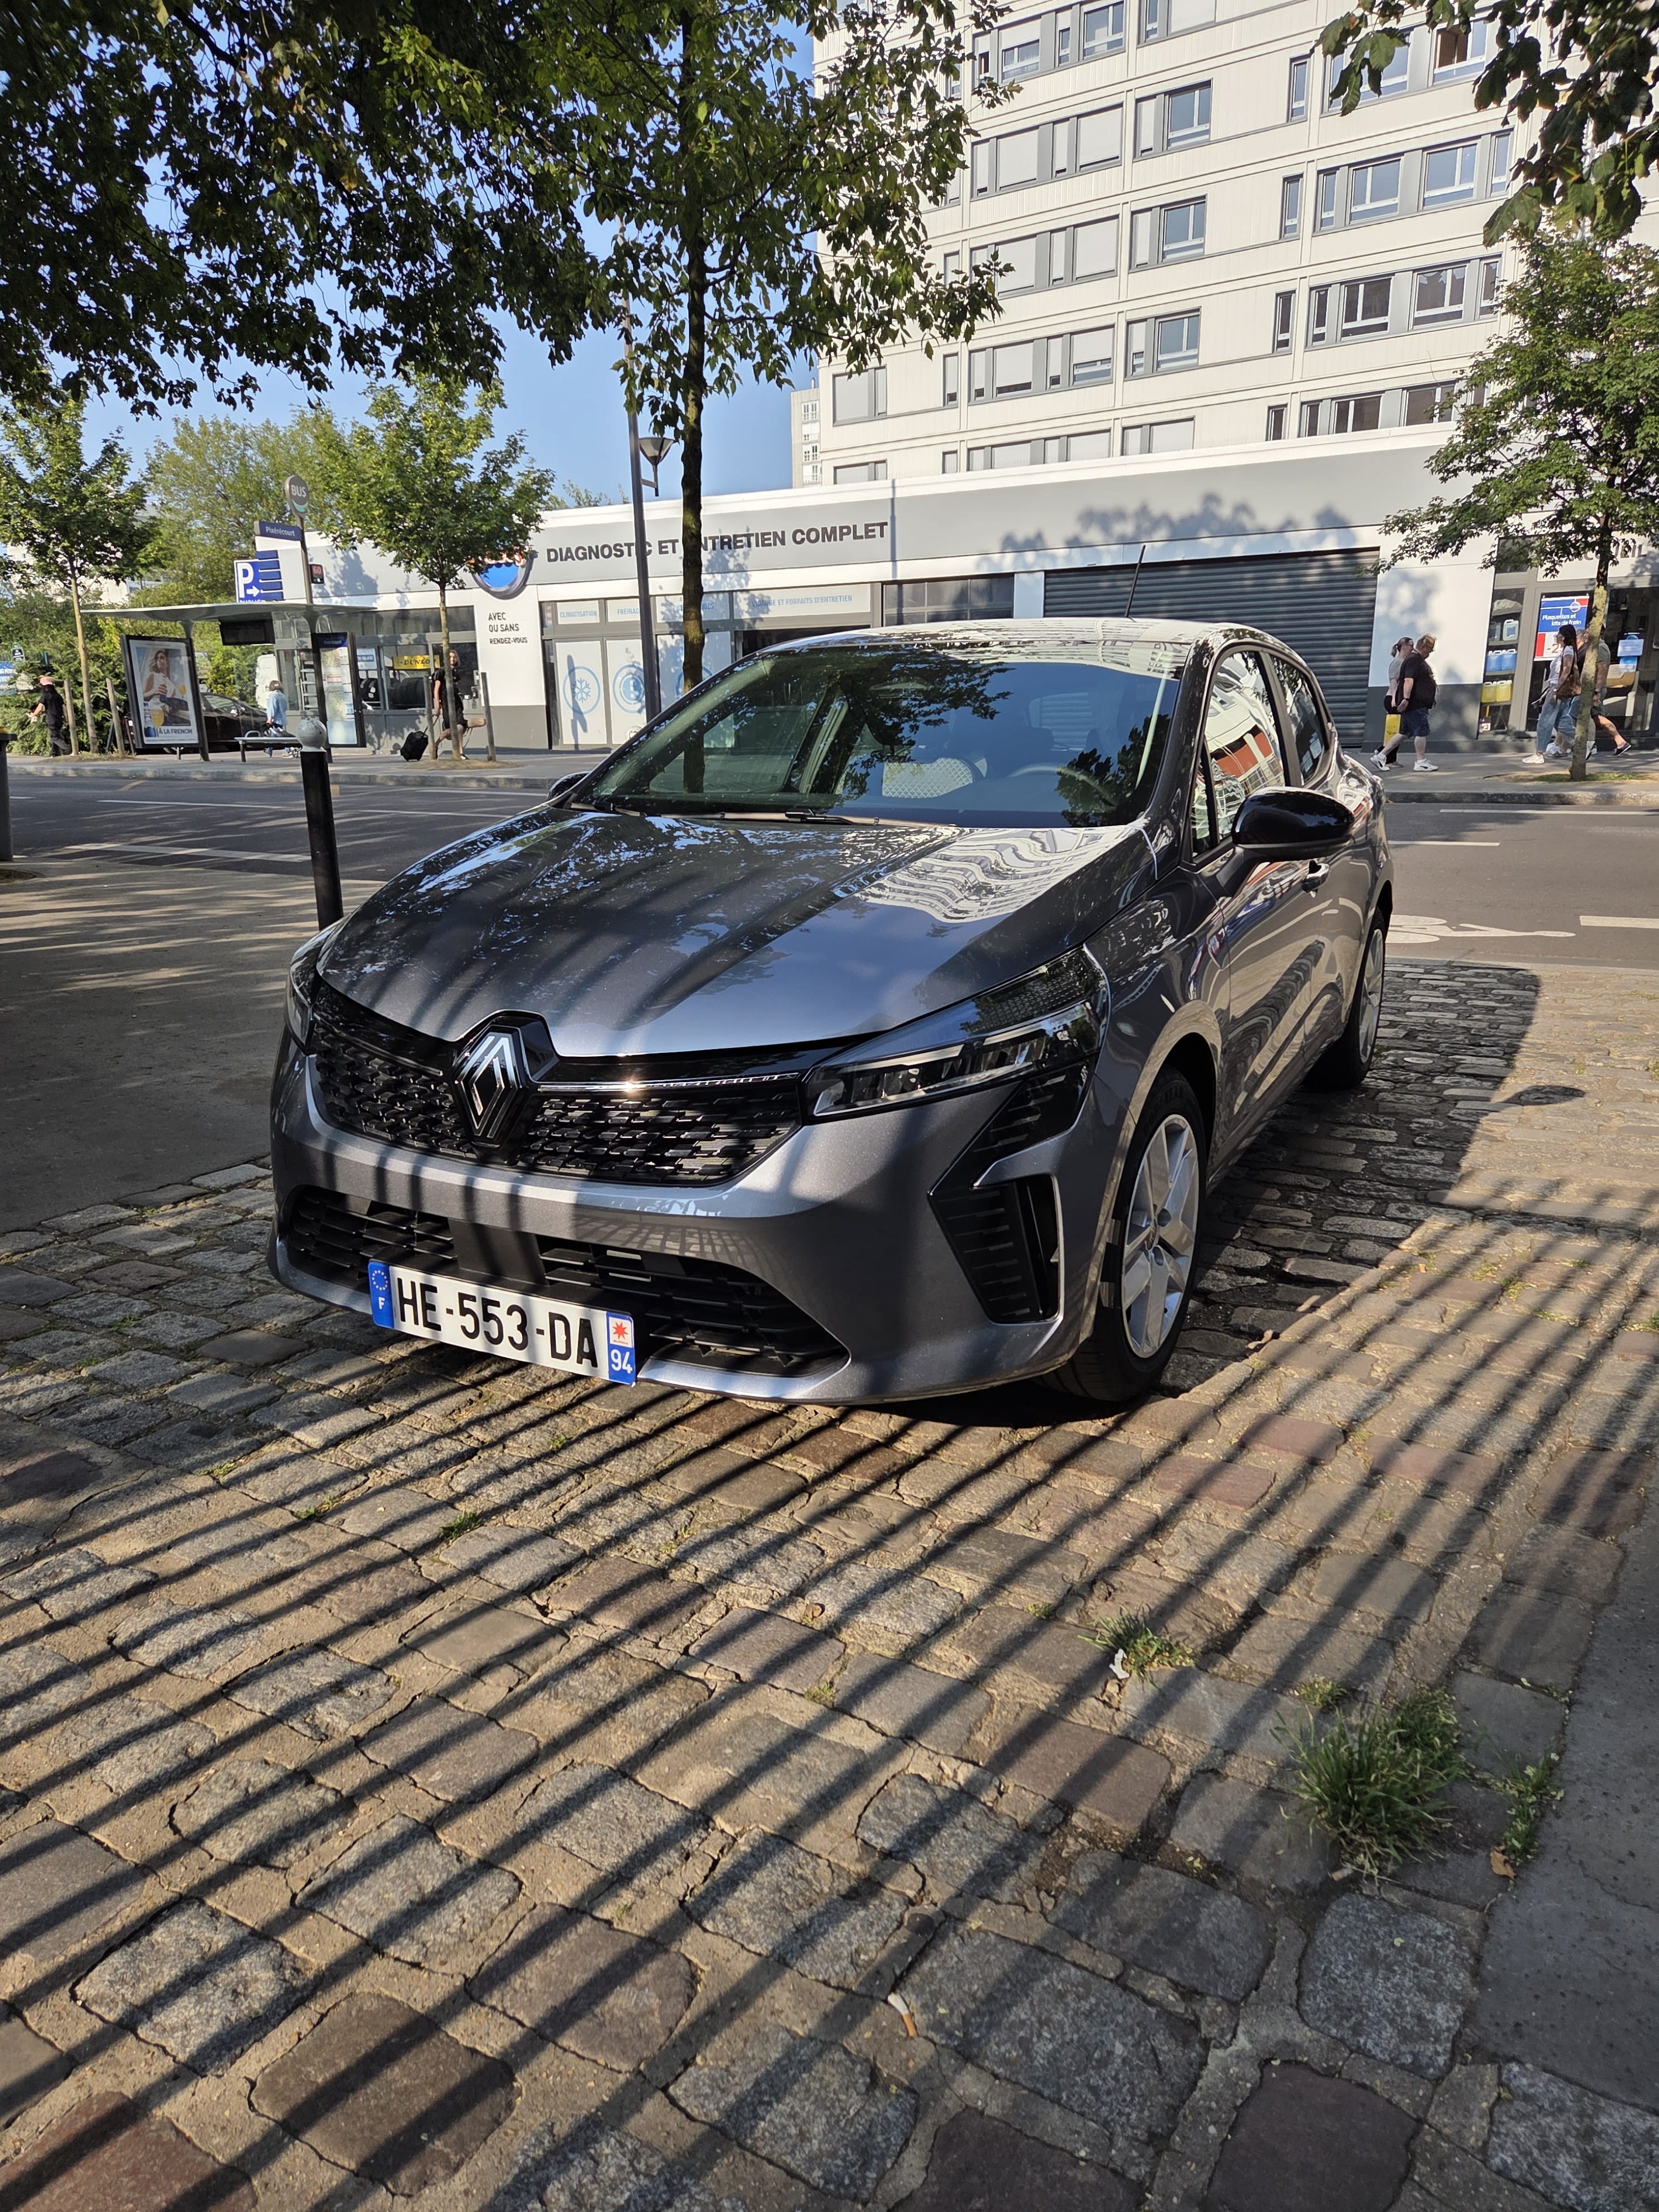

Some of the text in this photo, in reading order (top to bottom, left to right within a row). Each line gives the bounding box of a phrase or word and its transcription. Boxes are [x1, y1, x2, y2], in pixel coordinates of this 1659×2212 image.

[291, 484, 307, 498] BUS
[547, 541, 653, 562] DIAGNOSTC
[658, 539, 679, 555] ET
[701, 530, 786, 552] NTRETIEN
[792, 521, 888, 545] COMPLET
[237, 562, 254, 598] P
[488, 612, 506, 621] AVEC
[489, 623, 519, 633] OU SANS
[489, 637, 528, 645] RENDEZ-VOUS
[378, 1297, 385, 1310] F
[397, 1277, 598, 1368] HE-553-DA
[611, 1349, 633, 1374] 94
